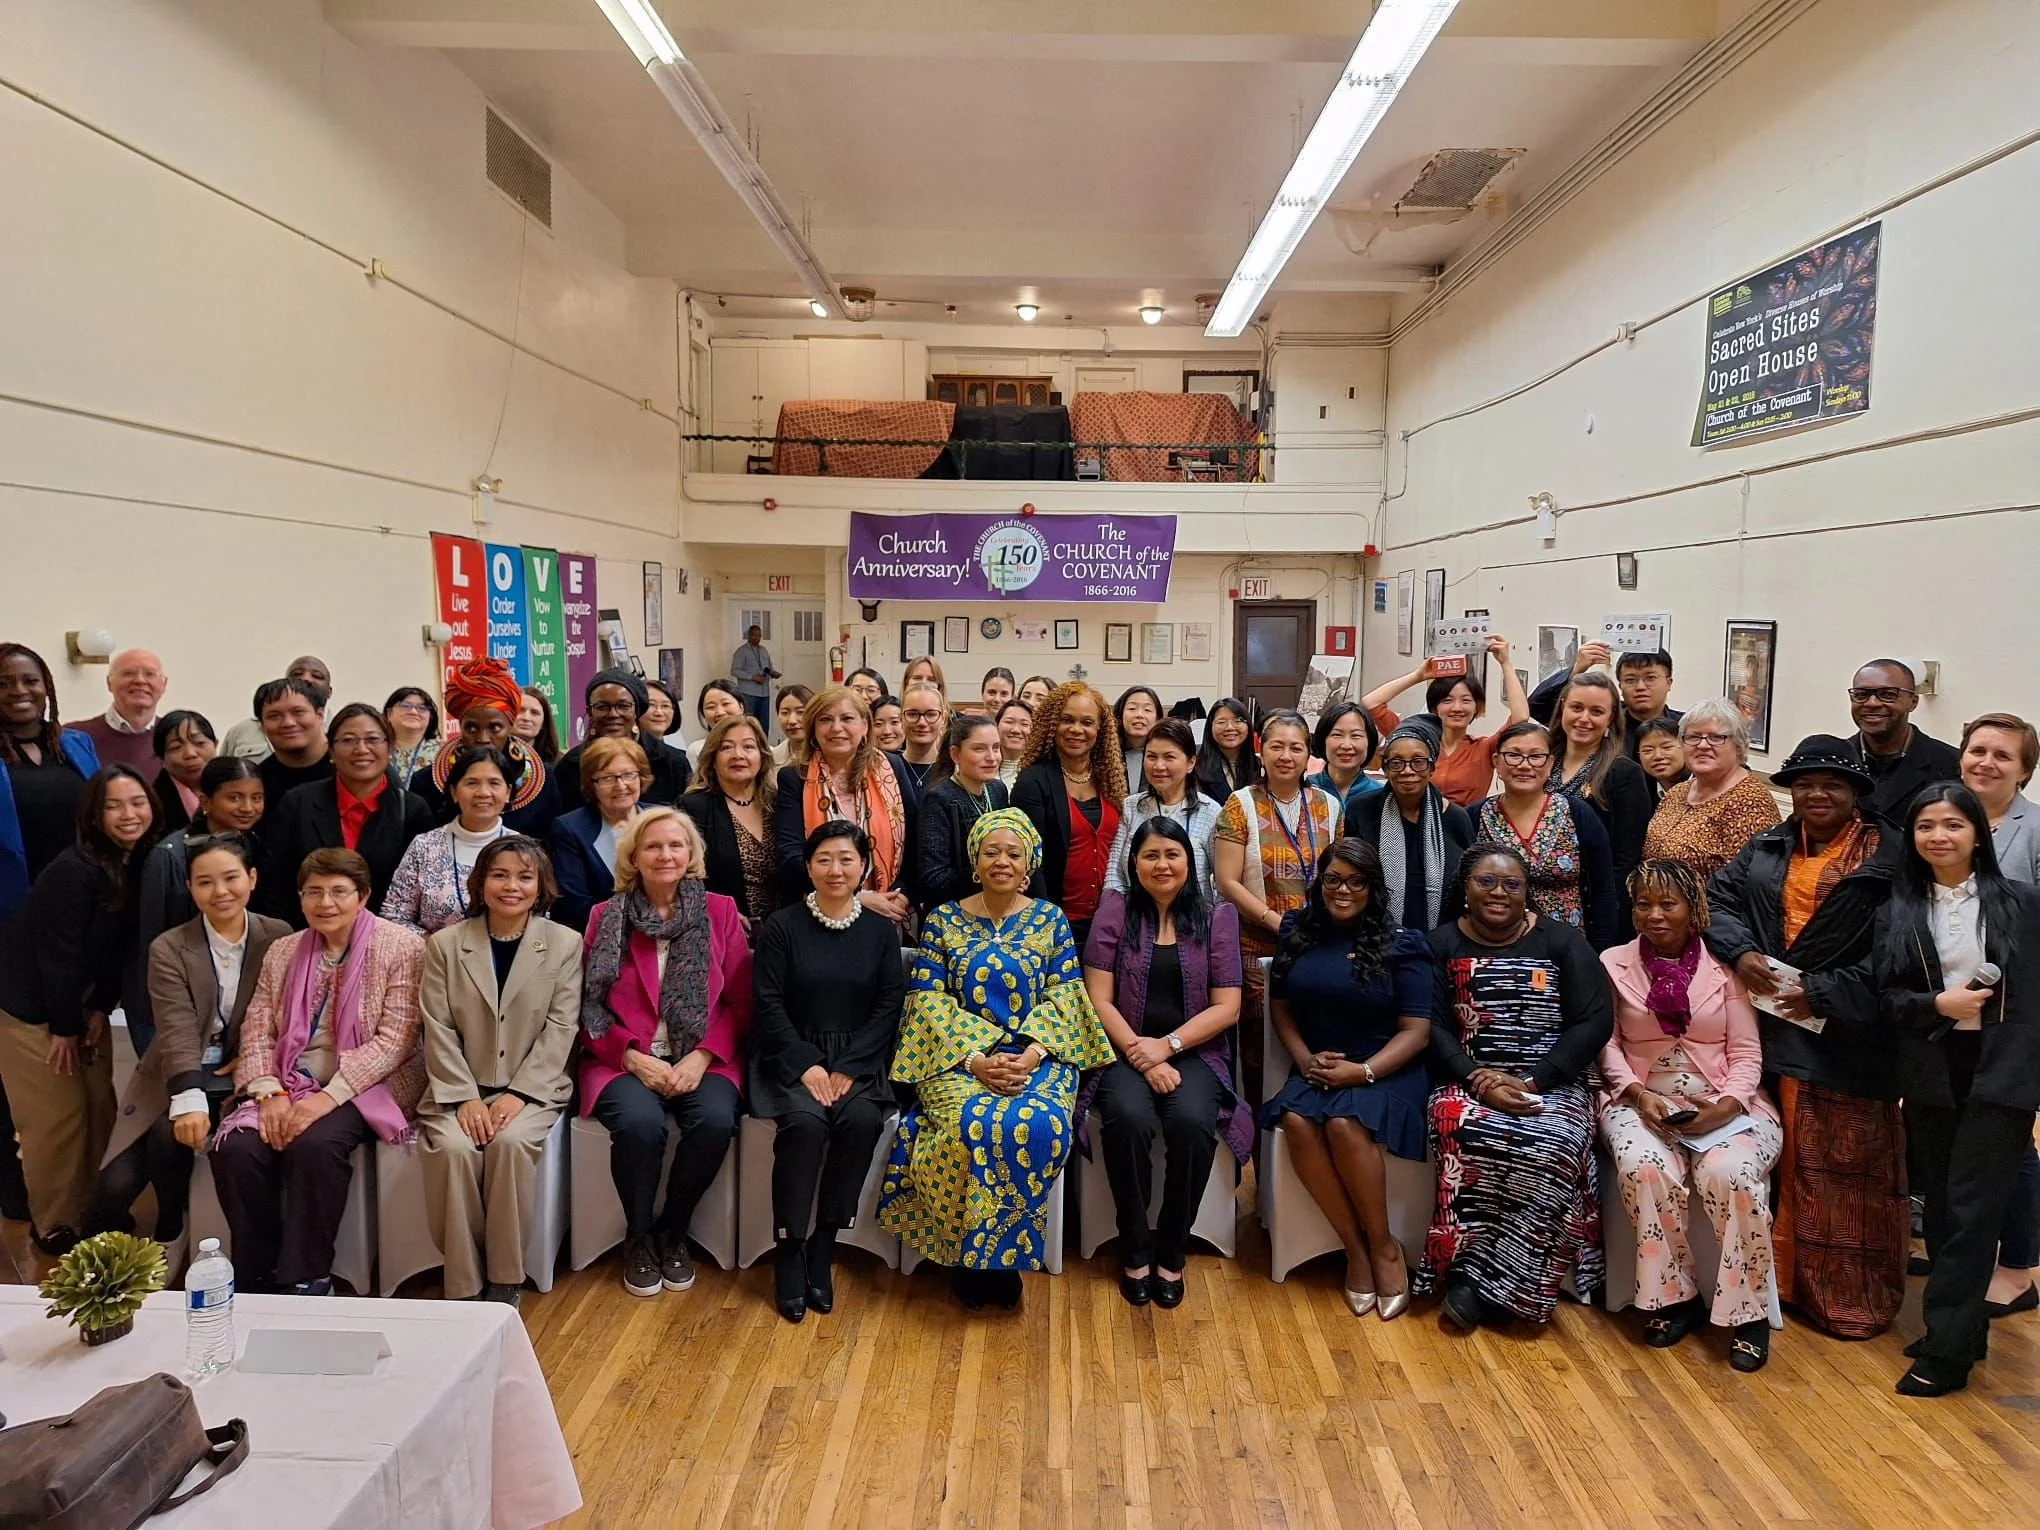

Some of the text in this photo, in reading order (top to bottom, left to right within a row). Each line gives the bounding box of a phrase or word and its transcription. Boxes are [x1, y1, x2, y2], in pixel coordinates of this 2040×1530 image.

[1810, 290, 1818, 301] of
[1818, 282, 1844, 298] Worship
[1710, 307, 1820, 364] Sacred Sites
[1708, 341, 1818, 395] Open House
[1707, 389, 1812, 427] Church of the Covenant
[973, 519, 1051, 562] THE CHURCH of the COVENANT
[1098, 522, 1126, 541] The
[879, 531, 948, 555] Church
[997, 544, 1038, 566] 150
[1053, 543, 1170, 564] CHURCH of the
[452, 546, 470, 587] L
[492, 552, 513, 591] O
[532, 557, 550, 592] V
[852, 558, 970, 586] Anniversary!
[1062, 562, 1160, 580] COVENANT
[569, 561, 583, 593] E
[768, 575, 791, 592] EXIT
[1084, 585, 1137, 596] 1866-2016
[1244, 579, 1268, 597] EXIT
[452, 593, 469, 613] Live
[492, 596, 515, 614] Order
[533, 598, 550, 614] Vow
[452, 620, 469, 637] out
[539, 620, 548, 635] to
[571, 620, 581, 635] the
[448, 641, 473, 660] Jesus
[493, 641, 517, 659] Under
[540, 660, 550, 676] All
[1437, 660, 1461, 670] PAE
